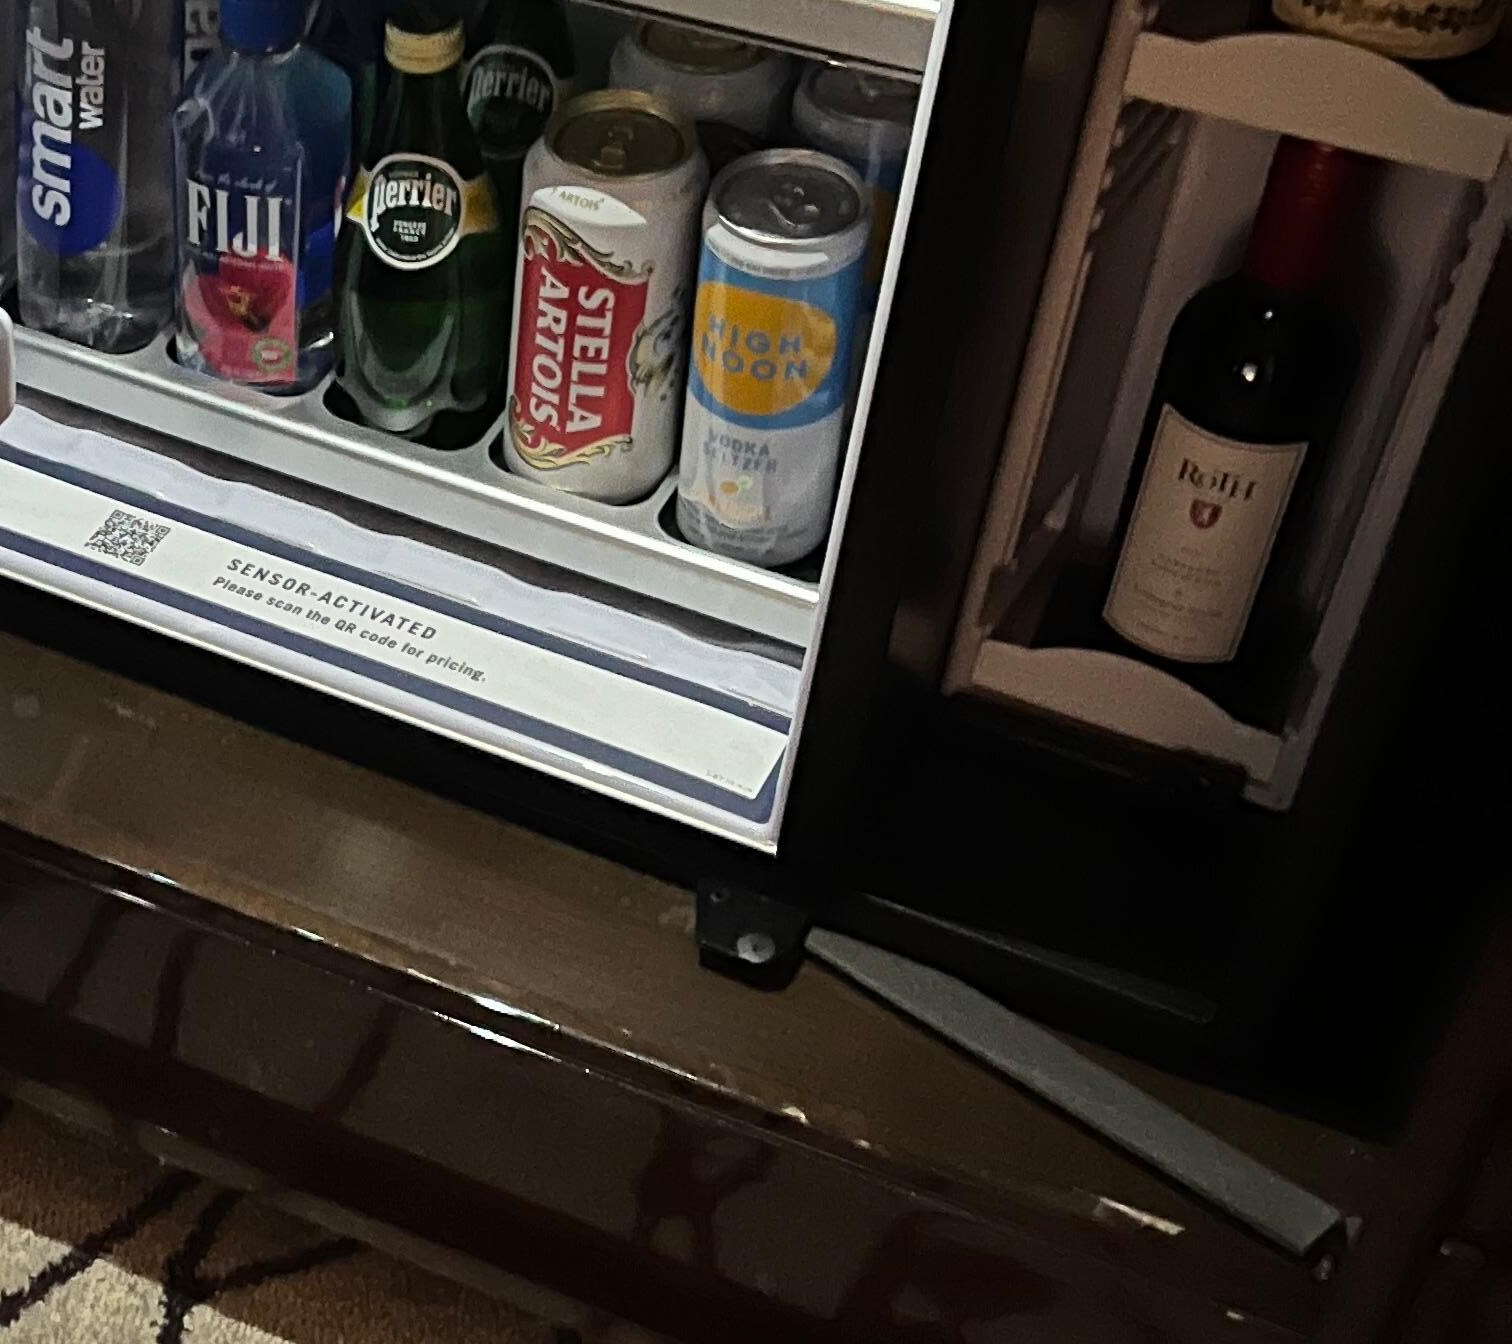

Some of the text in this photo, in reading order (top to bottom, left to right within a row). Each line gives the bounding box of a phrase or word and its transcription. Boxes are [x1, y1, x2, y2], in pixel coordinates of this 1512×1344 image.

[25, 26, 75, 227] smart
[75, 40, 107, 131] water
[187, 178, 284, 263] FIJI
[529, 265, 571, 433] ARTOIS
[565, 284, 626, 434] STELLA
[701, 331, 808, 383] NOON
[709, 311, 803, 356] HIGH
[707, 428, 771, 458] VODKA
[212, 575, 488, 684] Please scan the QR code for pricing.
[227, 558, 438, 640] SENSOR-ACTIVATED
